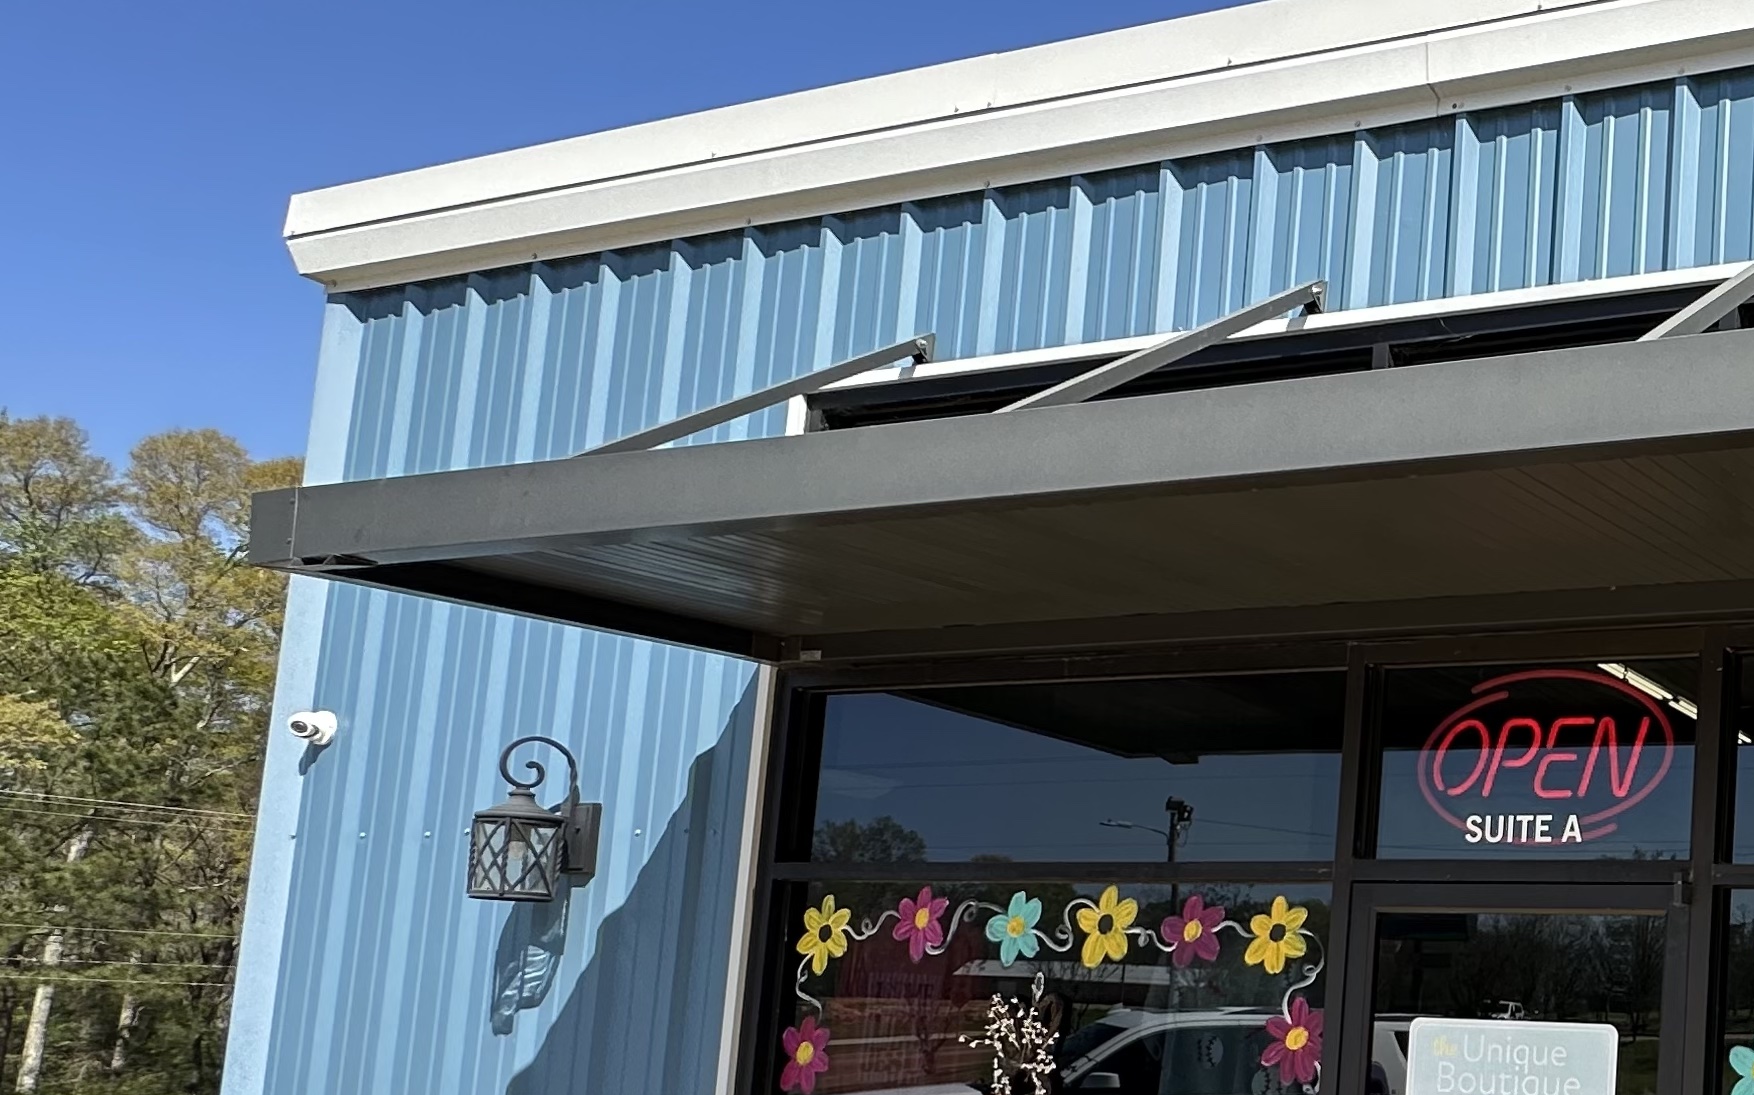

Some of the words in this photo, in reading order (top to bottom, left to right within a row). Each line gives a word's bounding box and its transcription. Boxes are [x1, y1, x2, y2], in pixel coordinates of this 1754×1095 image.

[1433, 717, 1650, 799] OPEN
[1465, 814, 1553, 844] SUITE
[1561, 814, 1583, 843] A
[1463, 1034, 1568, 1075] Unique
